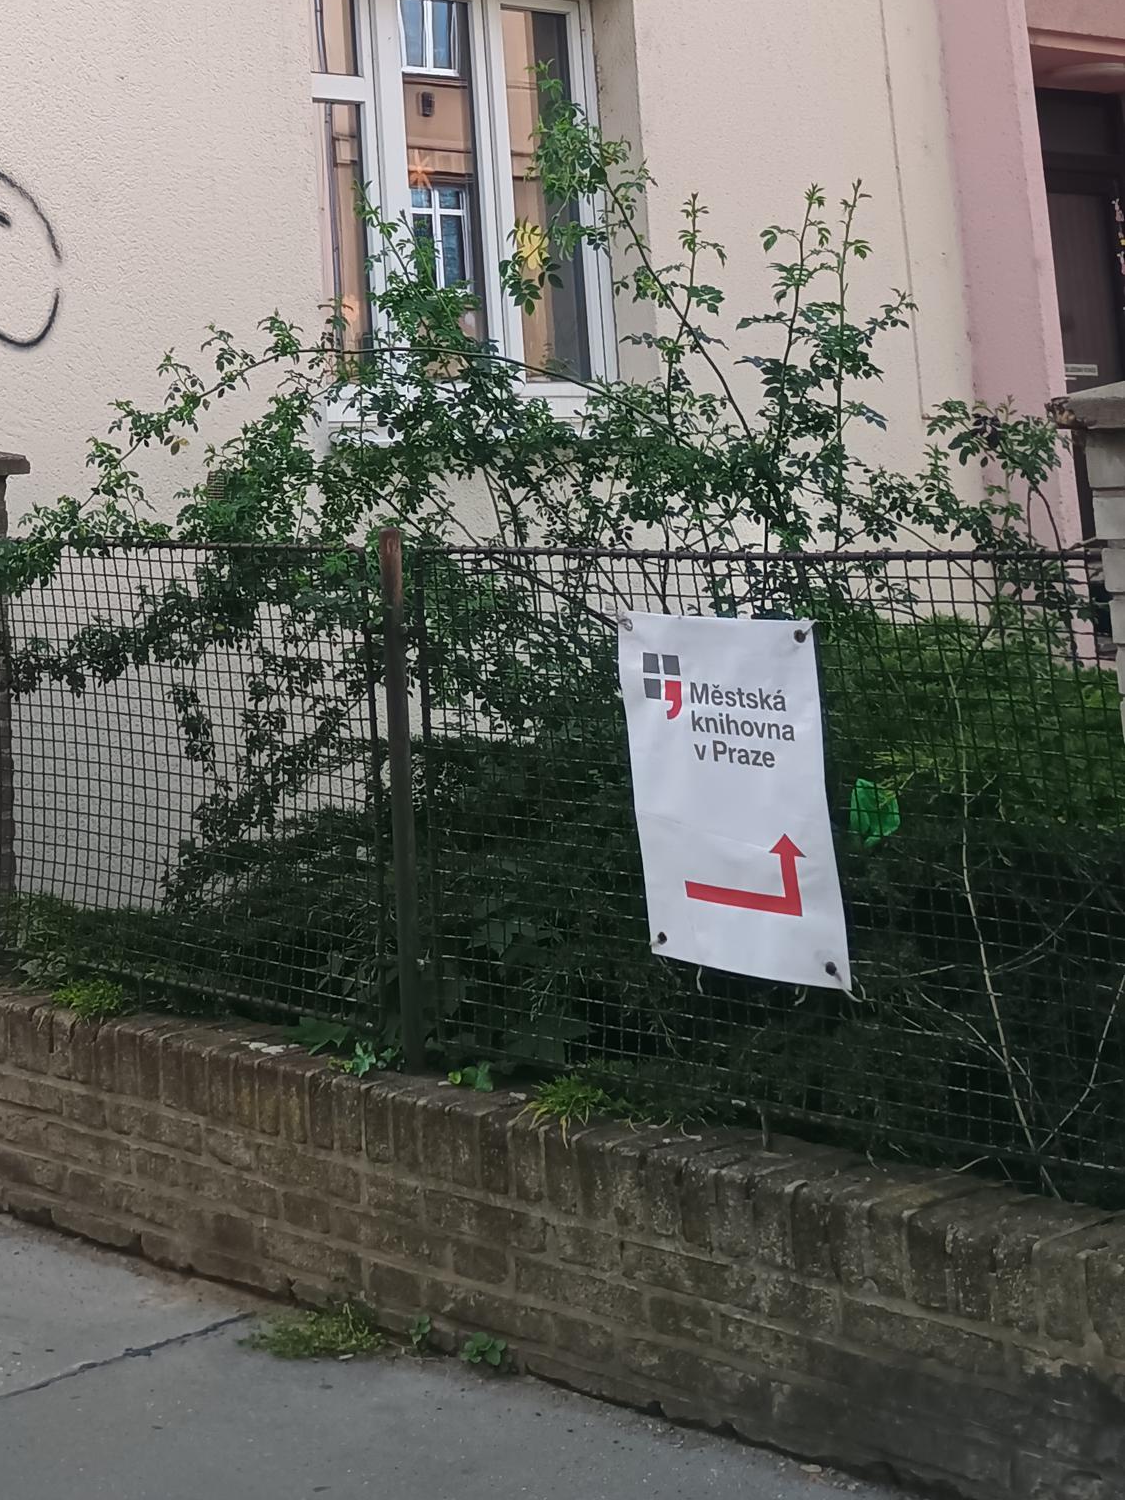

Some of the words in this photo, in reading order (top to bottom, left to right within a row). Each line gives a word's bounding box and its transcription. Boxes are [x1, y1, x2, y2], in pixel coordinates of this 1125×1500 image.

[689, 681, 786, 712] Městská
[691, 711, 795, 742] knihovna
[694, 744, 706, 761] v
[712, 740, 776, 768] Praze
